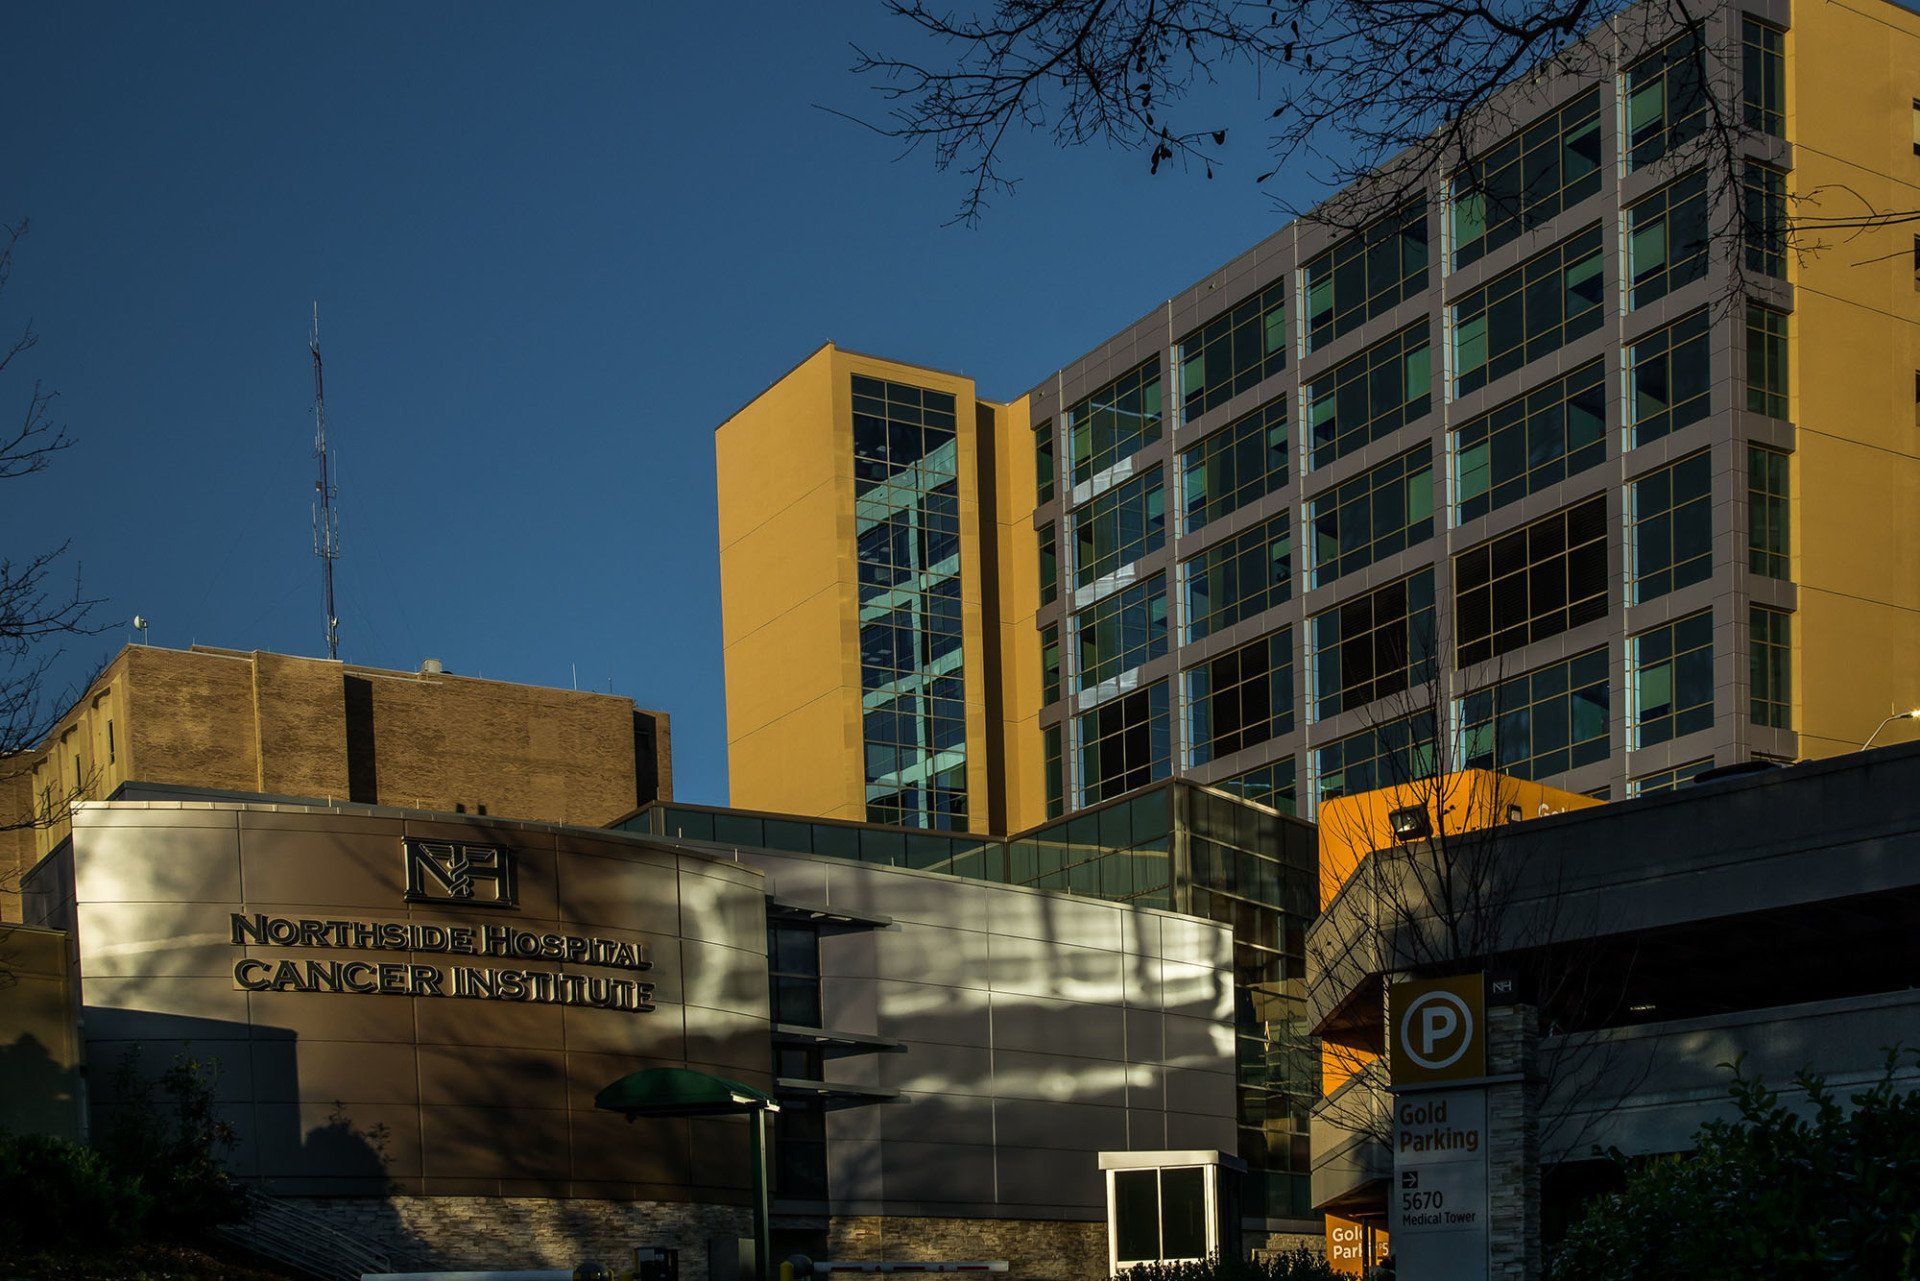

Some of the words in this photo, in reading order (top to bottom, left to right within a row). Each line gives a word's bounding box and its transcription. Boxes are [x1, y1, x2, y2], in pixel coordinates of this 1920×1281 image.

[230, 913, 476, 954] NORTHSIDE
[481, 924, 654, 970] HOSPITAL
[234, 958, 443, 996] CANCER
[450, 966, 657, 1012] INSTITUTE
[1423, 1006, 1457, 1054] P
[1400, 1101, 1447, 1125] Gold
[1400, 1127, 1478, 1152] Parking
[1403, 1191, 1443, 1210] 5670
[1403, 1213, 1441, 1226] Medical
[1445, 1212, 1475, 1223] Tower
[1332, 1226, 1362, 1242] Gol
